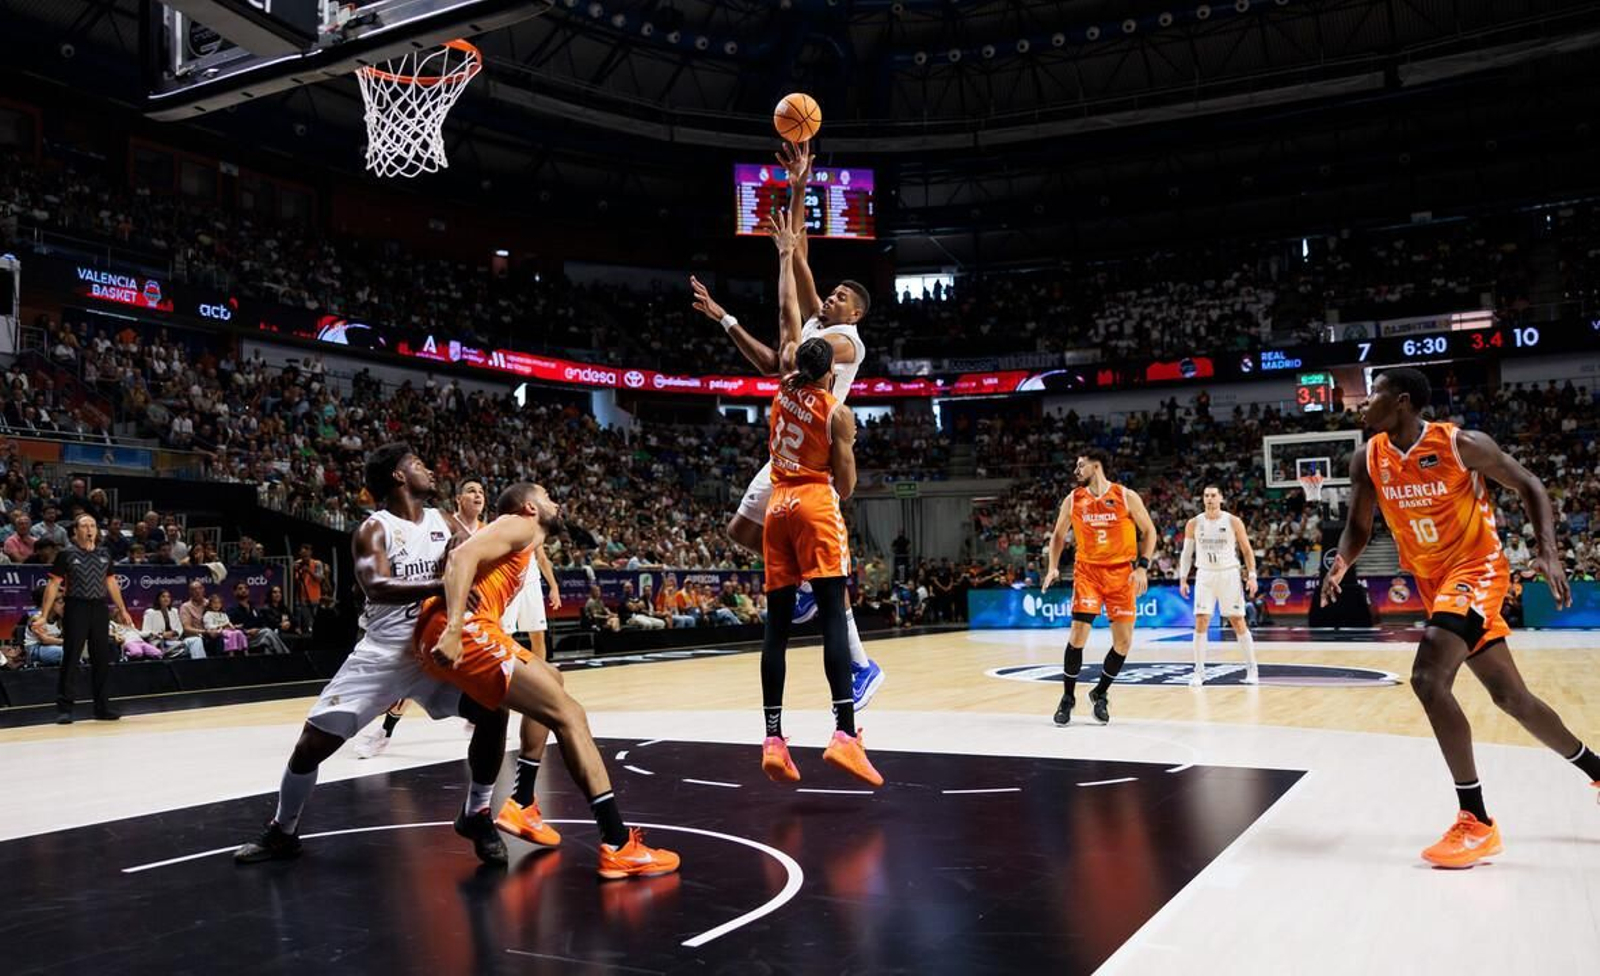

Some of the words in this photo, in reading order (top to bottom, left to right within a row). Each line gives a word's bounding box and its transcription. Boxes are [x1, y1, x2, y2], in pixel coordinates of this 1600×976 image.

[815, 172, 828, 182] 10
[76, 266, 137, 291] VALENCIA
[91, 284, 138, 303] BASKET
[199, 303, 231, 320] acb
[1357, 343, 1371, 361] 7
[1403, 336, 1448, 356] 6:30
[1472, 333, 1503, 350] 3.4
[1513, 328, 1539, 347] 10
[1261, 351, 1287, 360] REAL
[1261, 358, 1302, 370] MADRID
[564, 366, 616, 385] endesa
[1297, 386, 1325, 405] 3.1
[1382, 481, 1447, 500] VALENCIA
[1399, 498, 1433, 509] BASKET
[1081, 513, 1118, 522] VALENCIA
[1097, 529, 1107, 544] 2
[1409, 518, 1439, 544] 10
[1207, 552, 1217, 563] 11
[391, 559, 443, 578] Emira
[247, 575, 268, 586] acb
